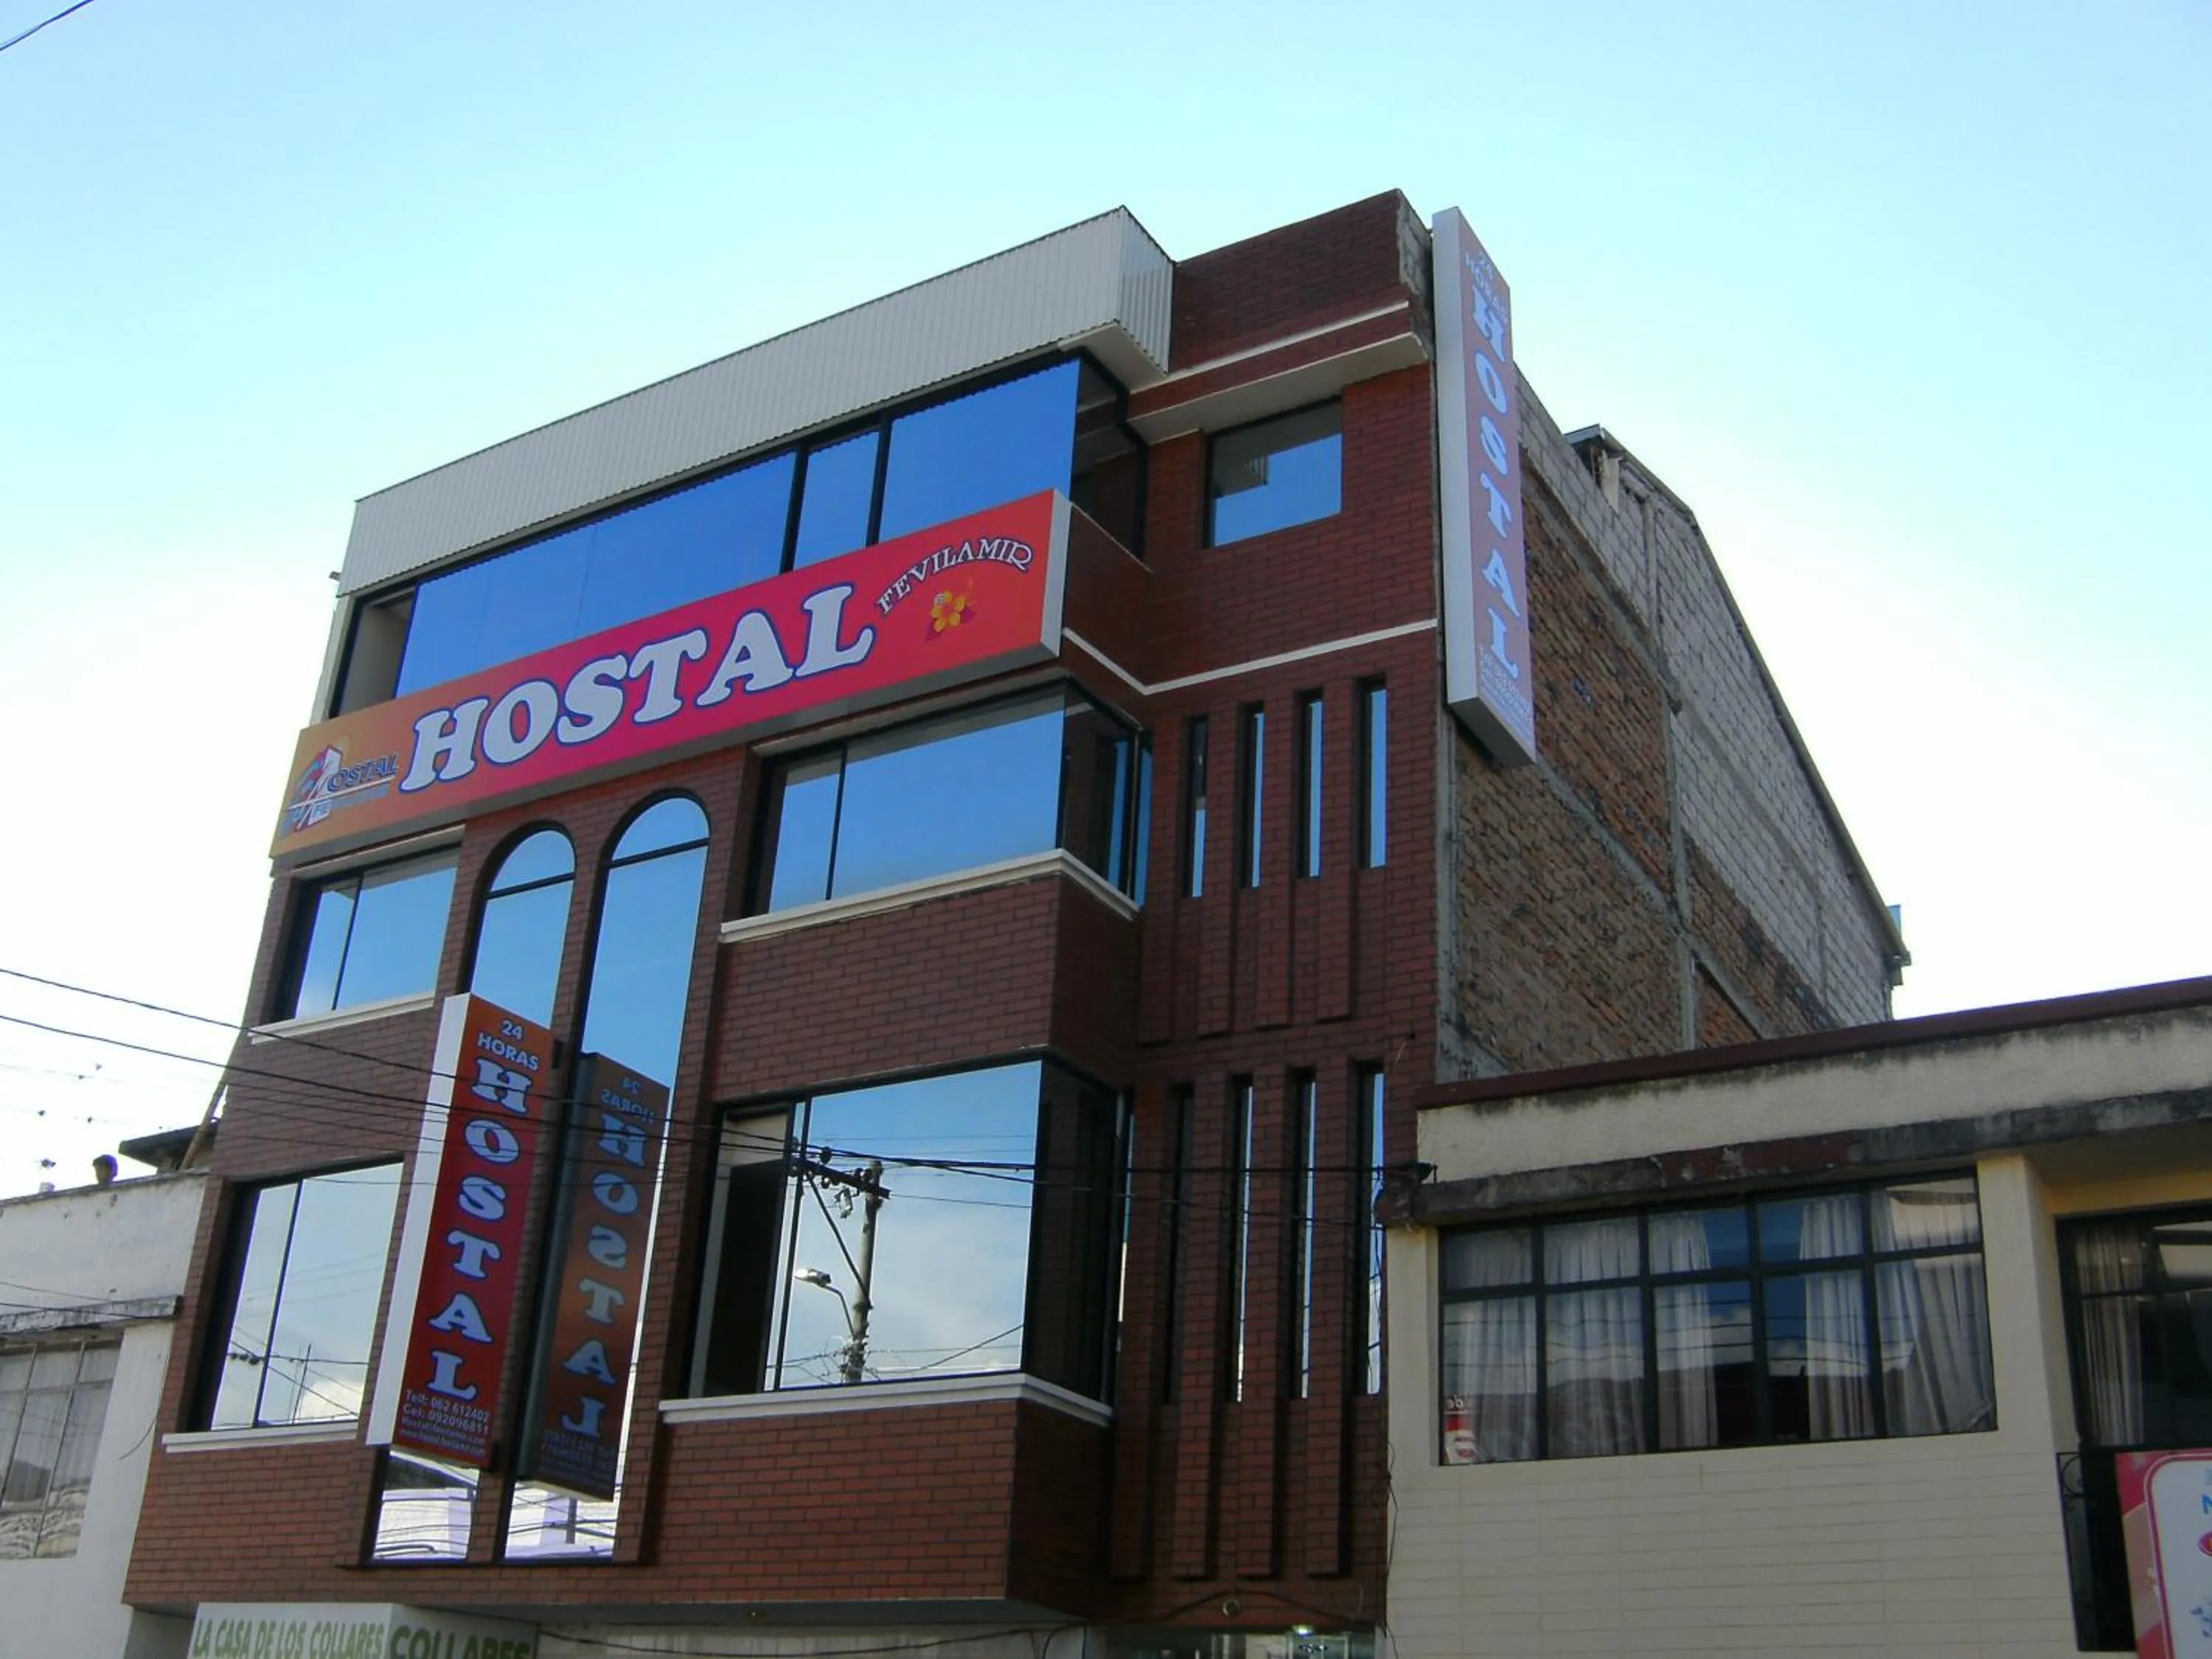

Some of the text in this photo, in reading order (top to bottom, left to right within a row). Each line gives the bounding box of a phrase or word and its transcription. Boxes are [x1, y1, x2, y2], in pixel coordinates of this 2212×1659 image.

[1472, 283, 1520, 680] HOSTAL
[874, 538, 1034, 616] FEVILAMIR
[398, 582, 876, 793] HOSTAL
[476, 1032, 540, 1071] HORAS
[501, 1019, 524, 1041] 24
[425, 1057, 533, 1401] HOSTAL
[193, 1618, 383, 1659] LA CASA DE LOS COLLARES
